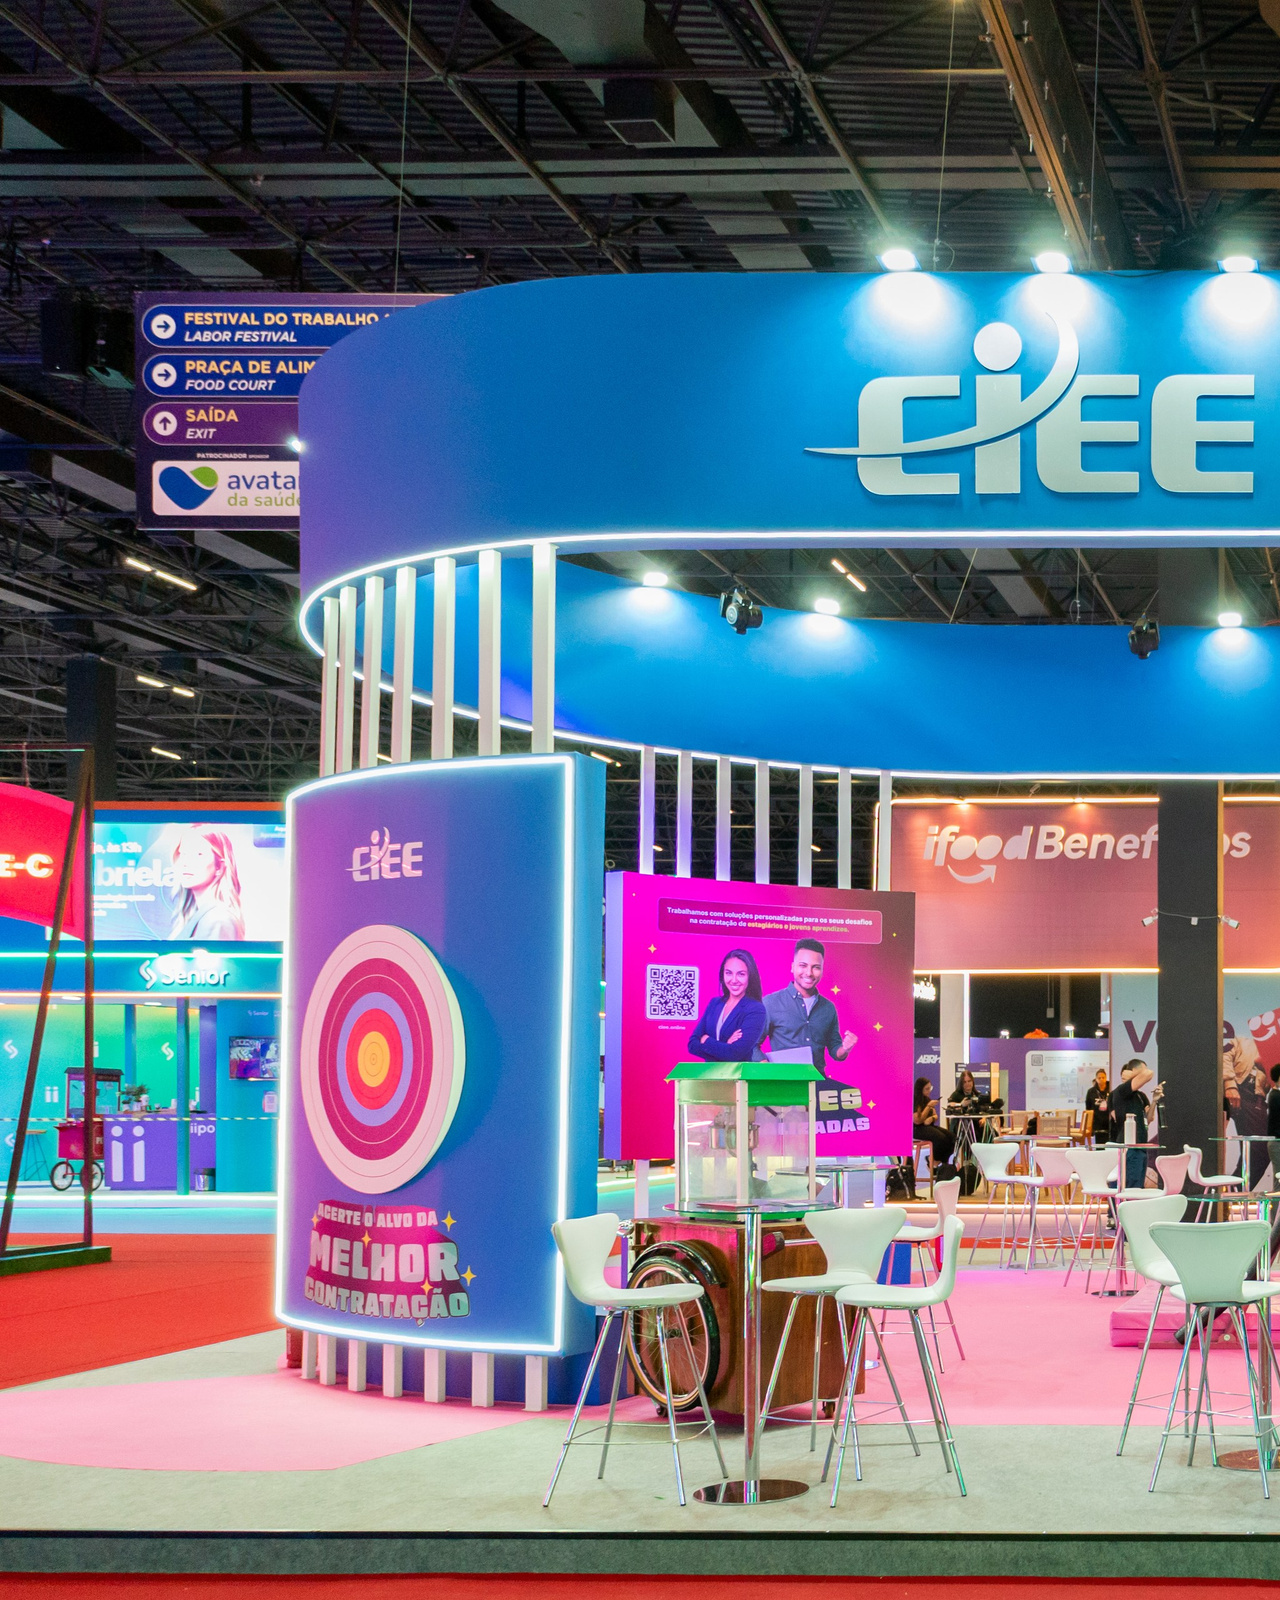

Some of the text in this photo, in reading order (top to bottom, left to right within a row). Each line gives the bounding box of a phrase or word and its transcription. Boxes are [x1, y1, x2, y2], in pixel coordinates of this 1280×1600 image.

[184, 312, 260, 326] FESTIVAL
[264, 312, 288, 326] DO
[292, 312, 379, 326] TRABALHO
[184, 331, 298, 343] LABOR FESTIVAL
[185, 360, 242, 376] PRAÇA
[248, 360, 271, 374] DE
[185, 380, 276, 391] FOOD COURT
[185, 405, 239, 423] SAÍDA
[185, 428, 218, 439] EXIT
[227, 471, 300, 490] avata
[227, 493, 249, 507] da
[667, 906, 709, 916] Trabalhamos
[725, 911, 754, 920] soluções
[754, 914, 803, 923] personalizadas
[845, 918, 873, 926] desafios
[699, 918, 737, 927] contratação
[748, 921, 783, 929] estagiários
[789, 923, 811, 931] jovens
[317, 1202, 439, 1228] ACERTE O ALVO DA
[310, 1229, 461, 1283] MELHOR
[304, 1275, 471, 1327] CONTRATAÇÃO
